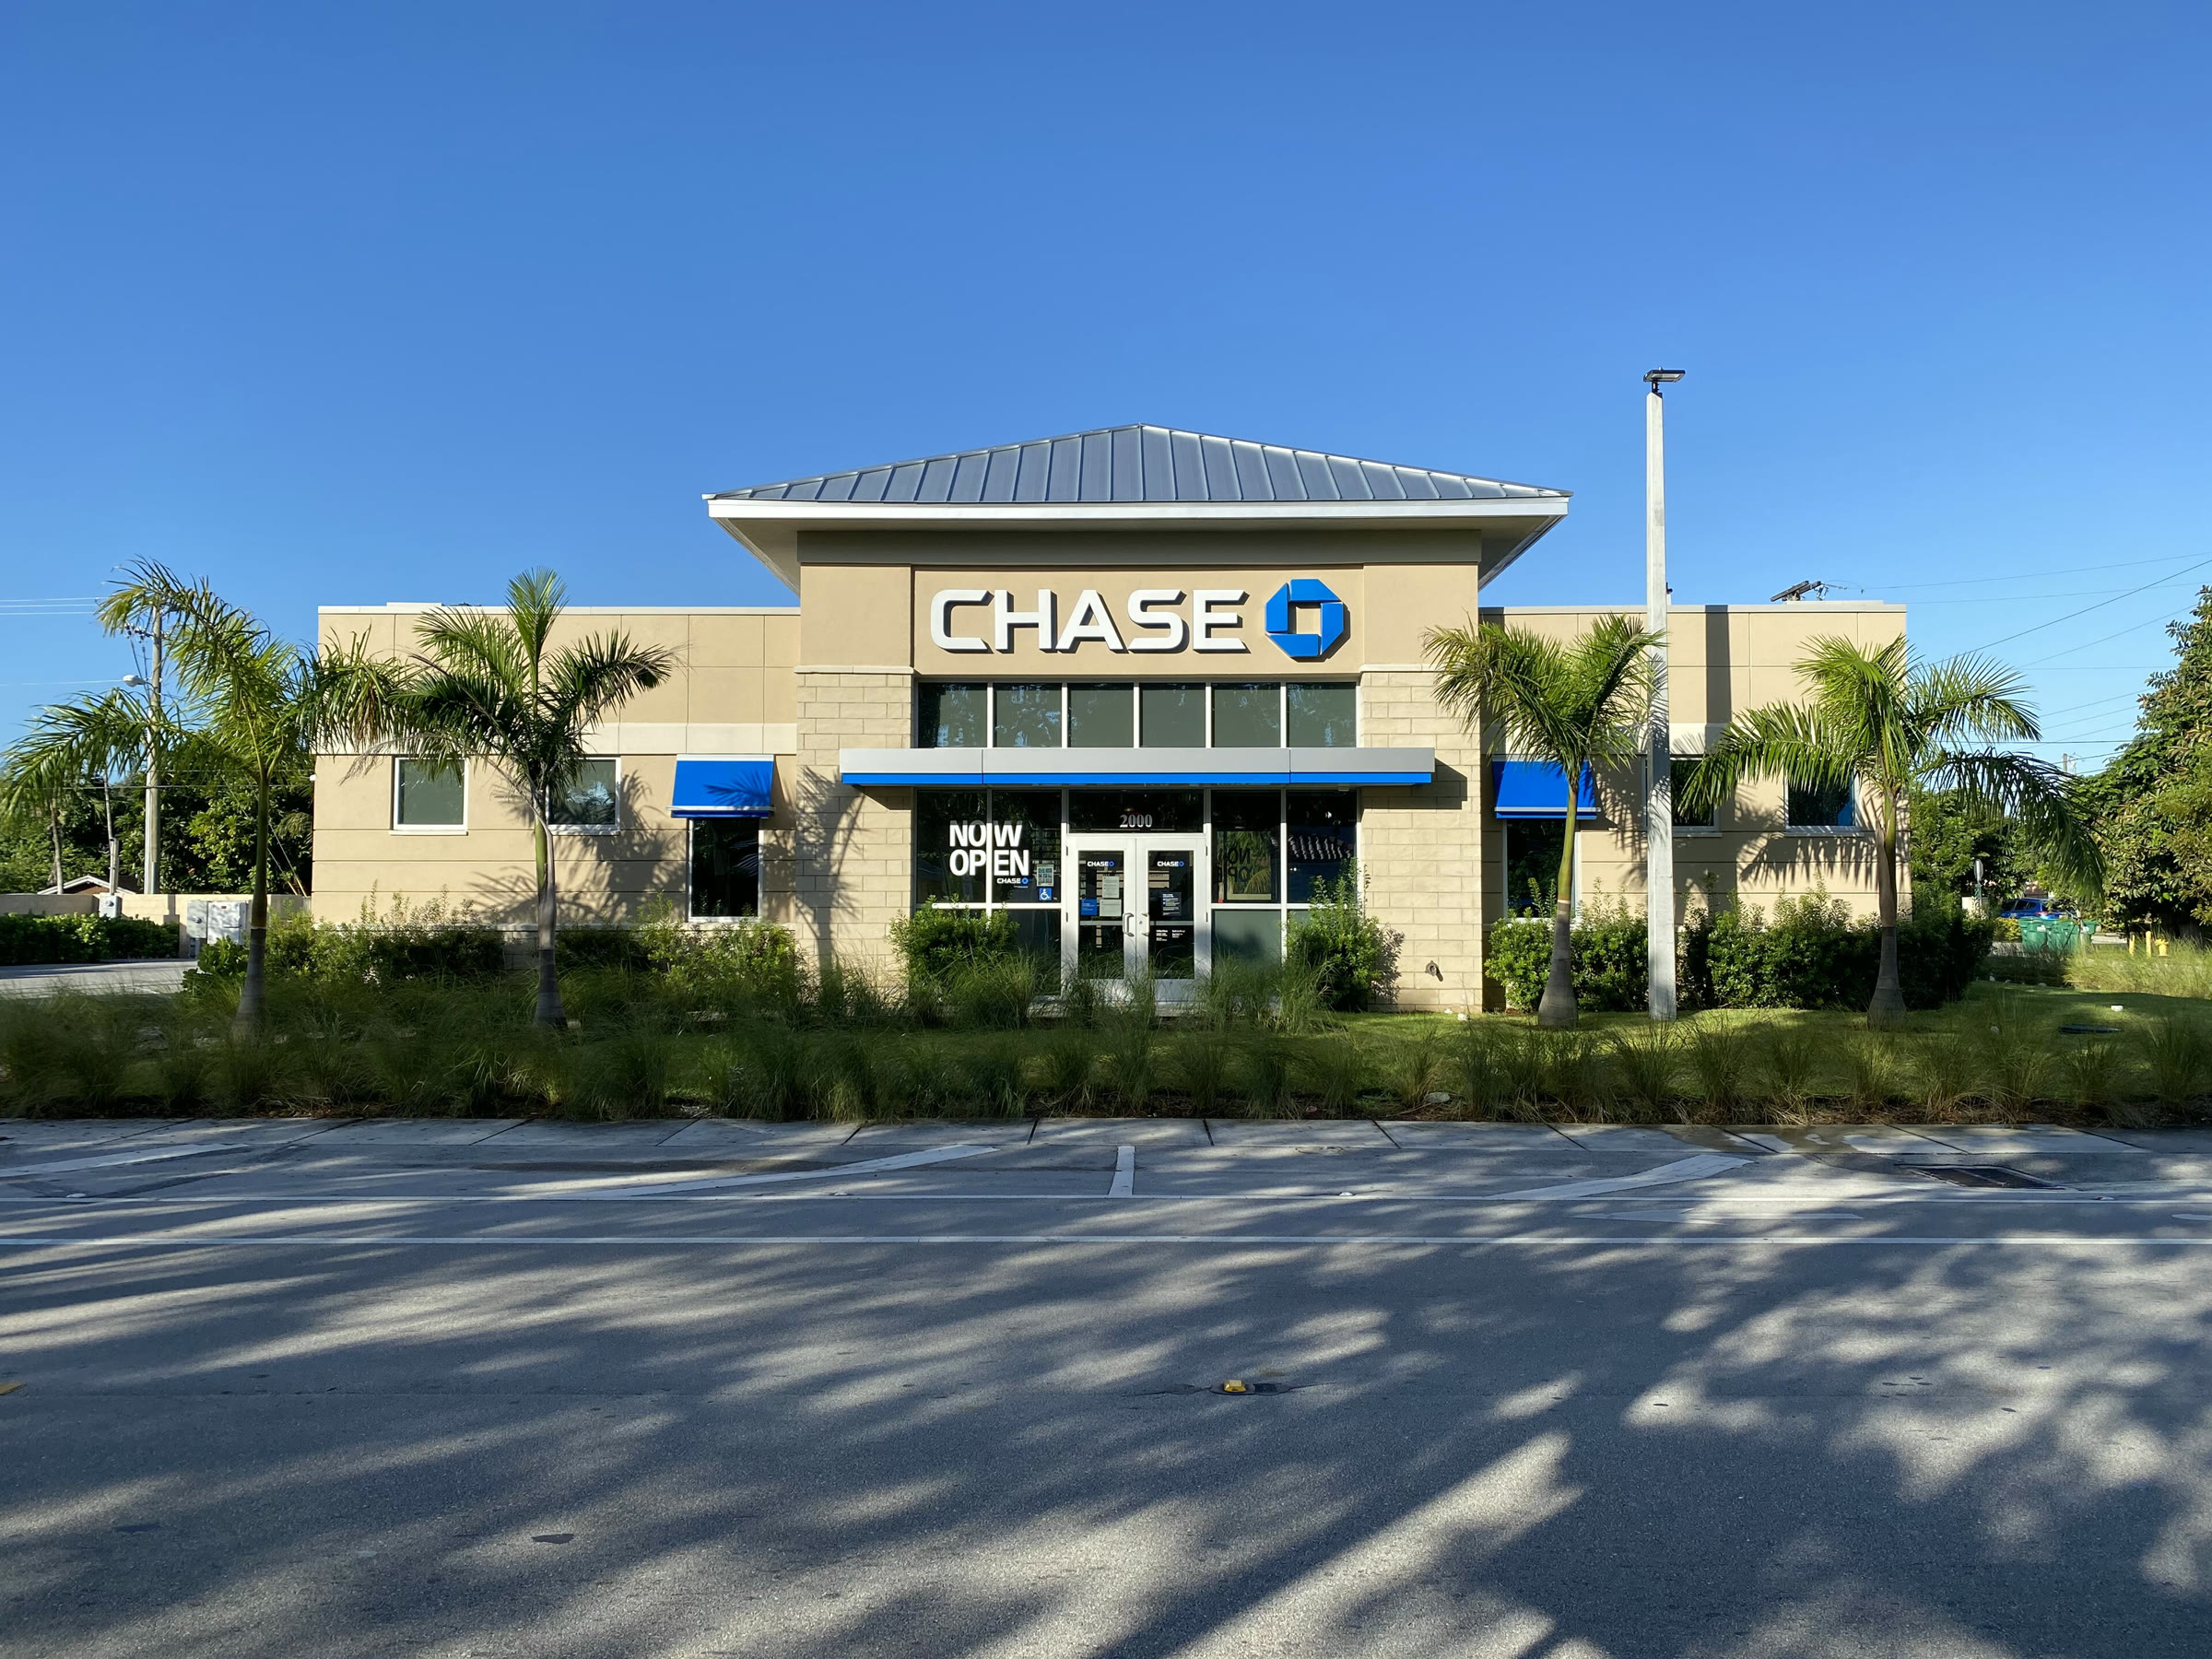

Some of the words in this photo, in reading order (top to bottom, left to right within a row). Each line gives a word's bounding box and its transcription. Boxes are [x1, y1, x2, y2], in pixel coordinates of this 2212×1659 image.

[930, 589, 1248, 652] CHASE
[949, 819, 1023, 847] NOW
[1119, 814, 1153, 828] 2000
[949, 849, 1030, 877] OPEN
